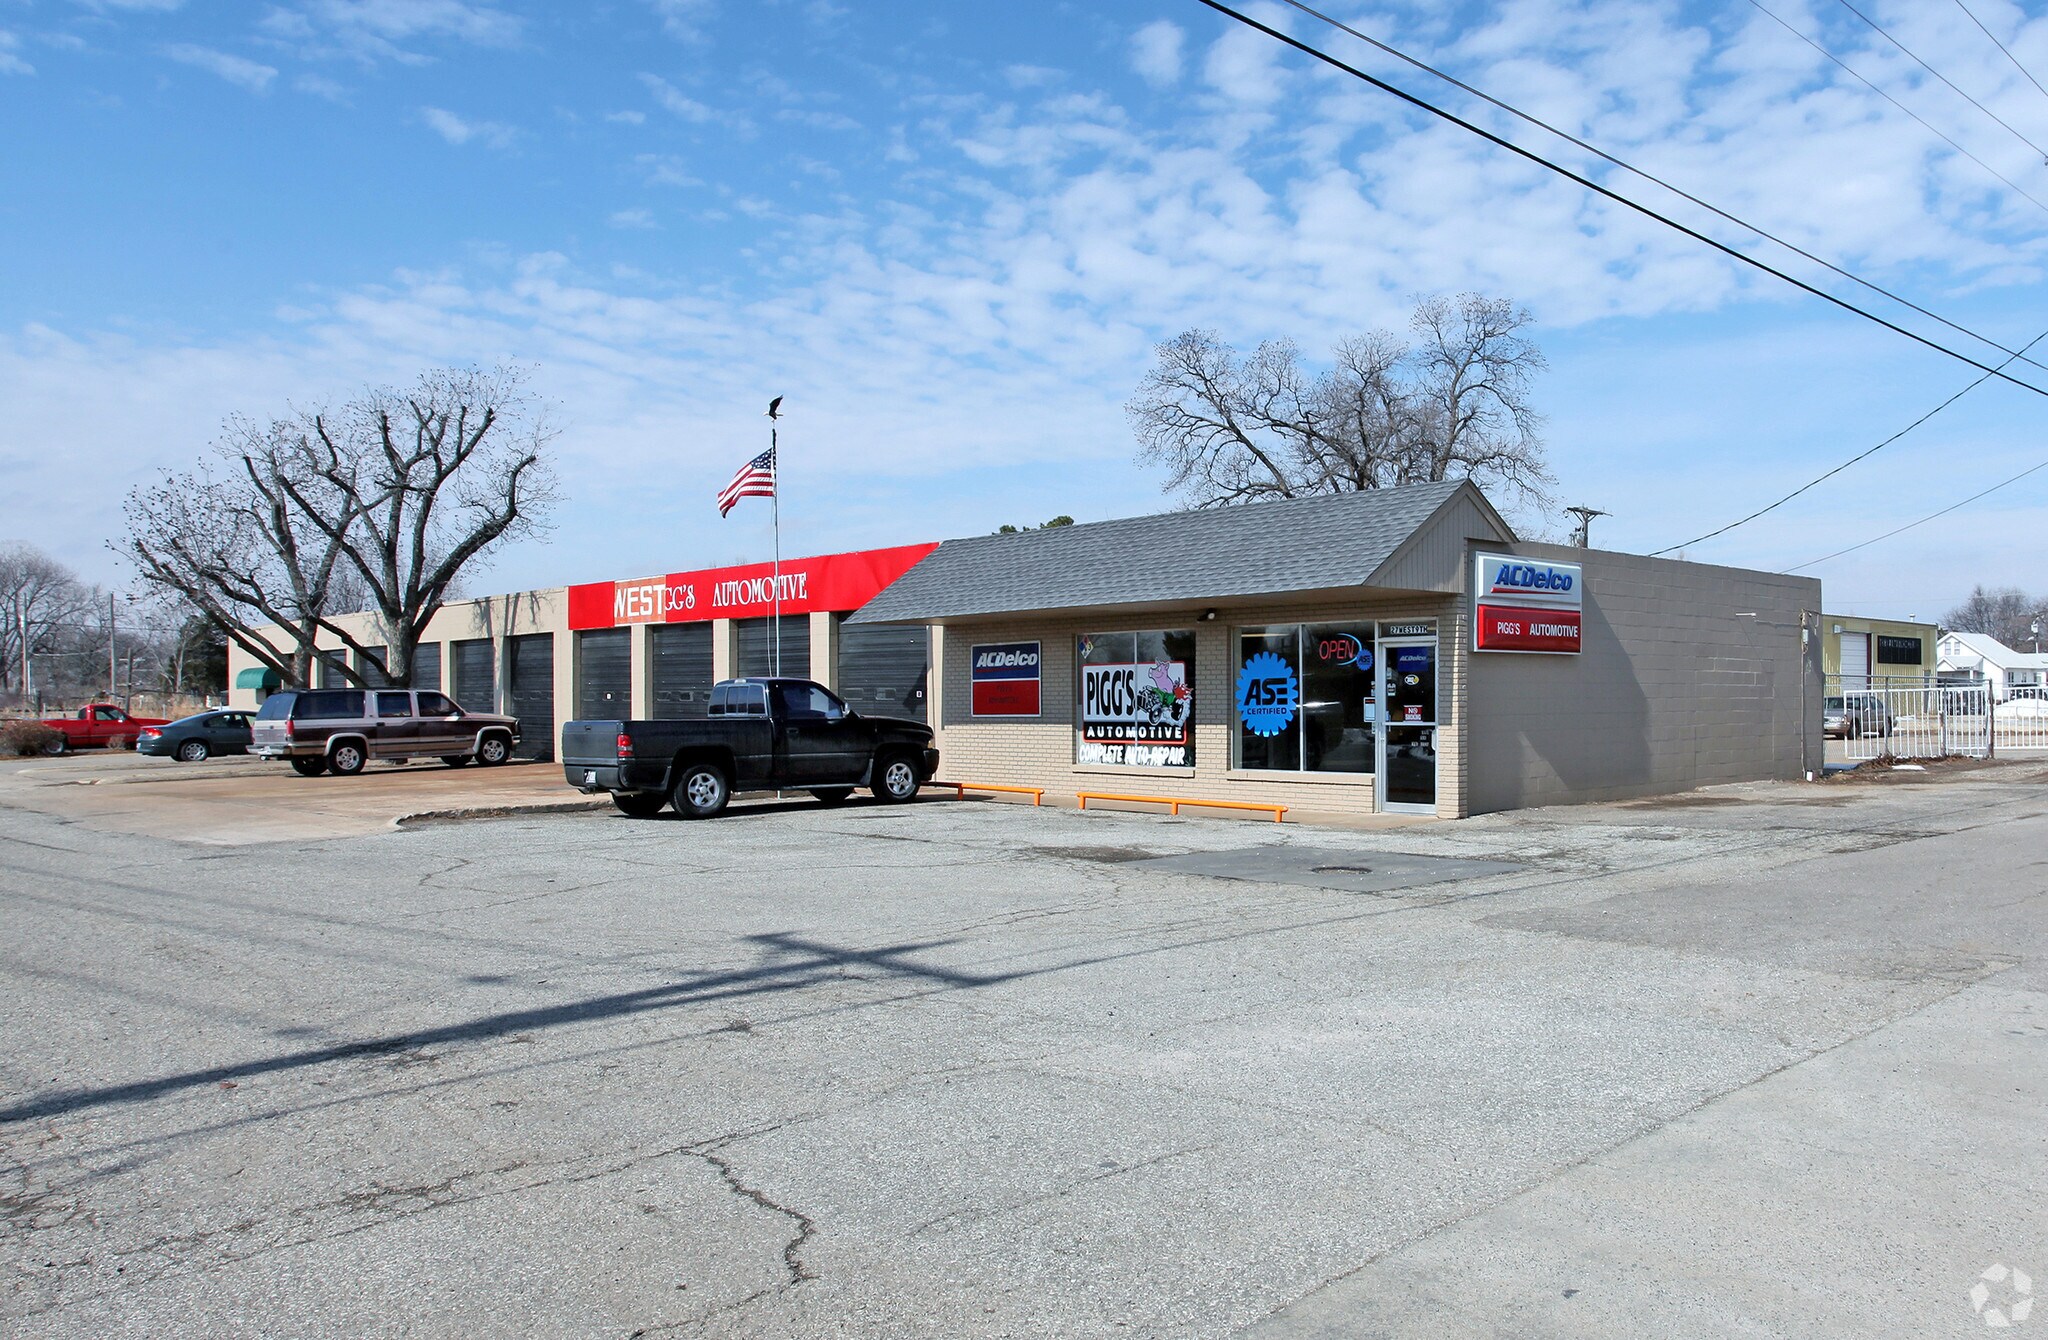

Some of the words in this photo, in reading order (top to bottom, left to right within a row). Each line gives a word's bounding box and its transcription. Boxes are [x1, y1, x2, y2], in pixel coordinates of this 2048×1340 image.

[1494, 563, 1573, 591] ACDelco
[712, 572, 808, 607] AUTOMOTIVE
[1497, 621, 1521, 635] PIGG'S
[1529, 623, 1579, 638] AUTOMOTIVE
[976, 650, 1038, 668] ACDelco
[1319, 640, 1355, 660] OPEN
[1086, 669, 1135, 717] PIGG'S
[1244, 677, 1288, 706] ASE
[1247, 707, 1287, 715] CERTIFIED
[1086, 726, 1183, 739] AUTOMOTIVE
[1079, 744, 1124, 764] COMPLETE
